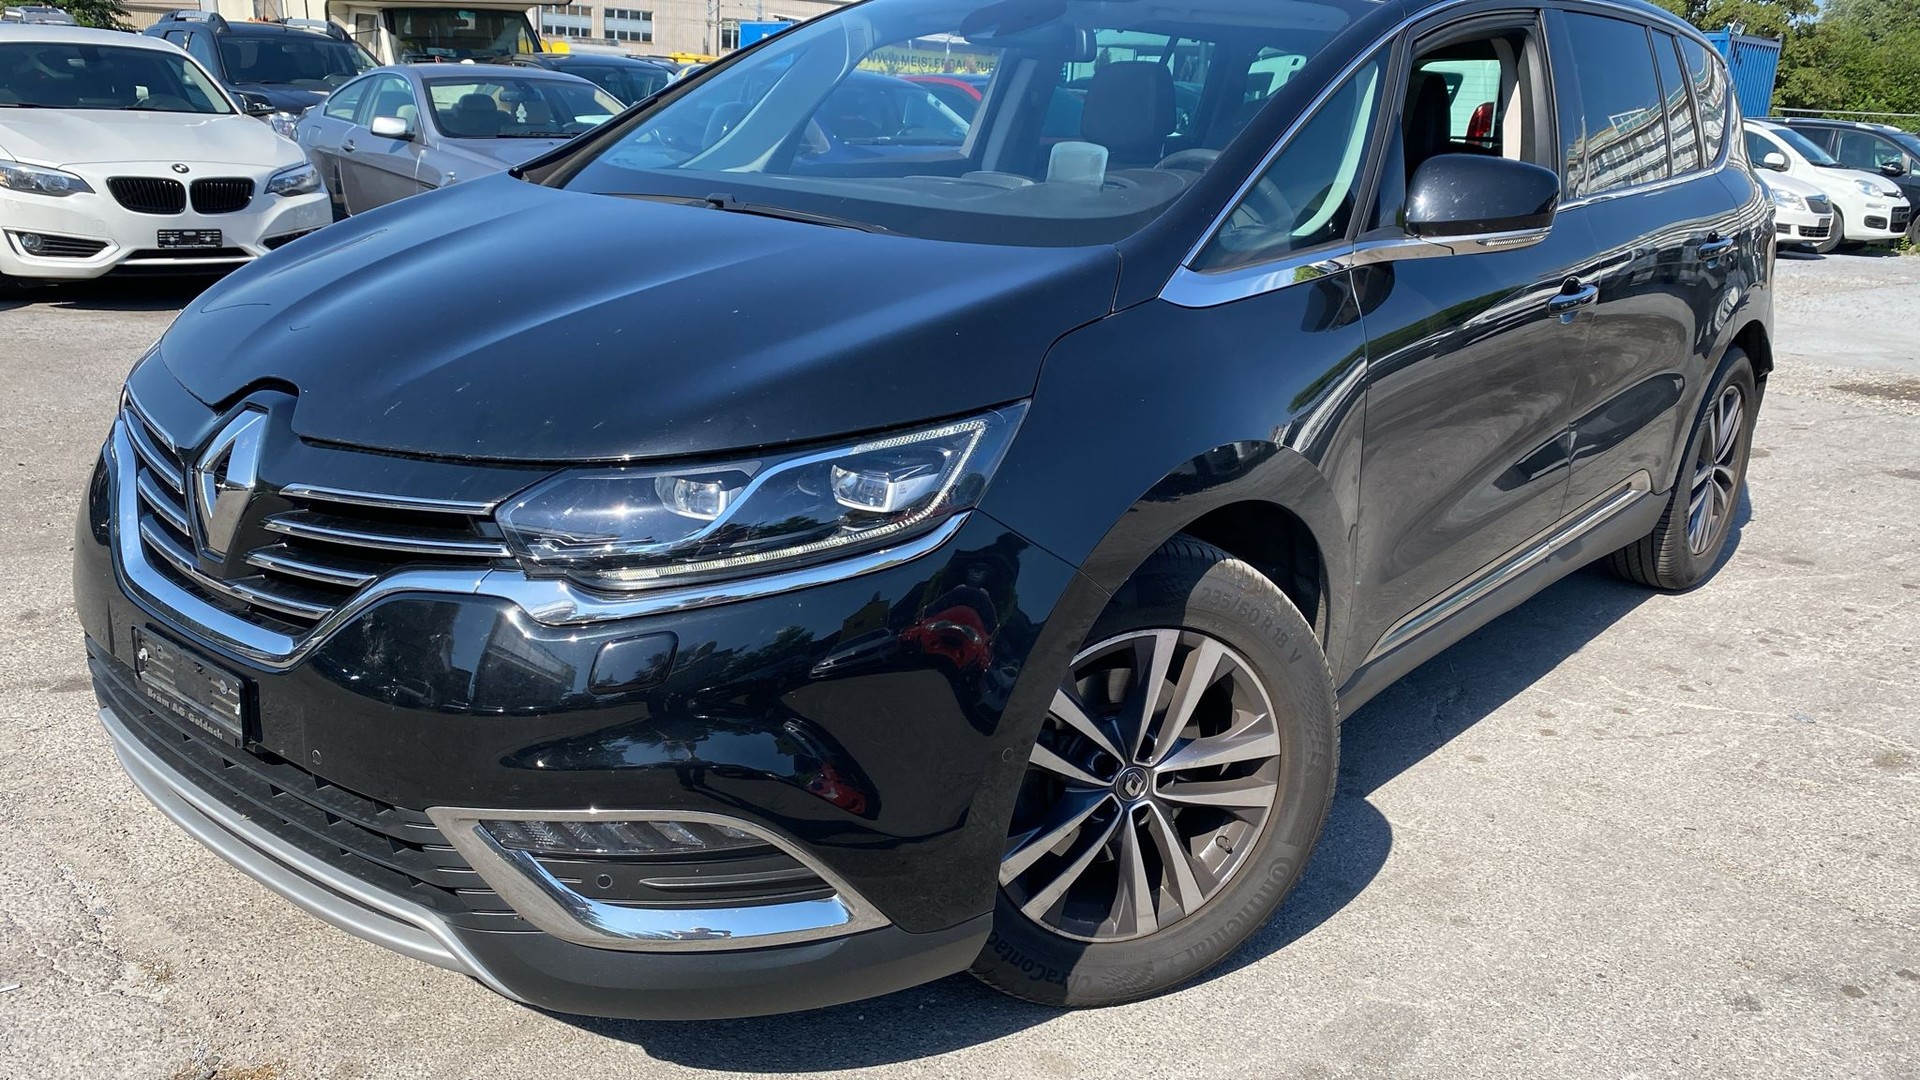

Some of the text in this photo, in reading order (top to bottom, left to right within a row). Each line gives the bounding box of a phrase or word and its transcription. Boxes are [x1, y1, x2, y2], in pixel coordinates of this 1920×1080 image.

[1273, 627, 1288, 648] 18
[1289, 648, 1302, 663] V
[172, 703, 185, 717] AG
[188, 712, 223, 740] Goldach
